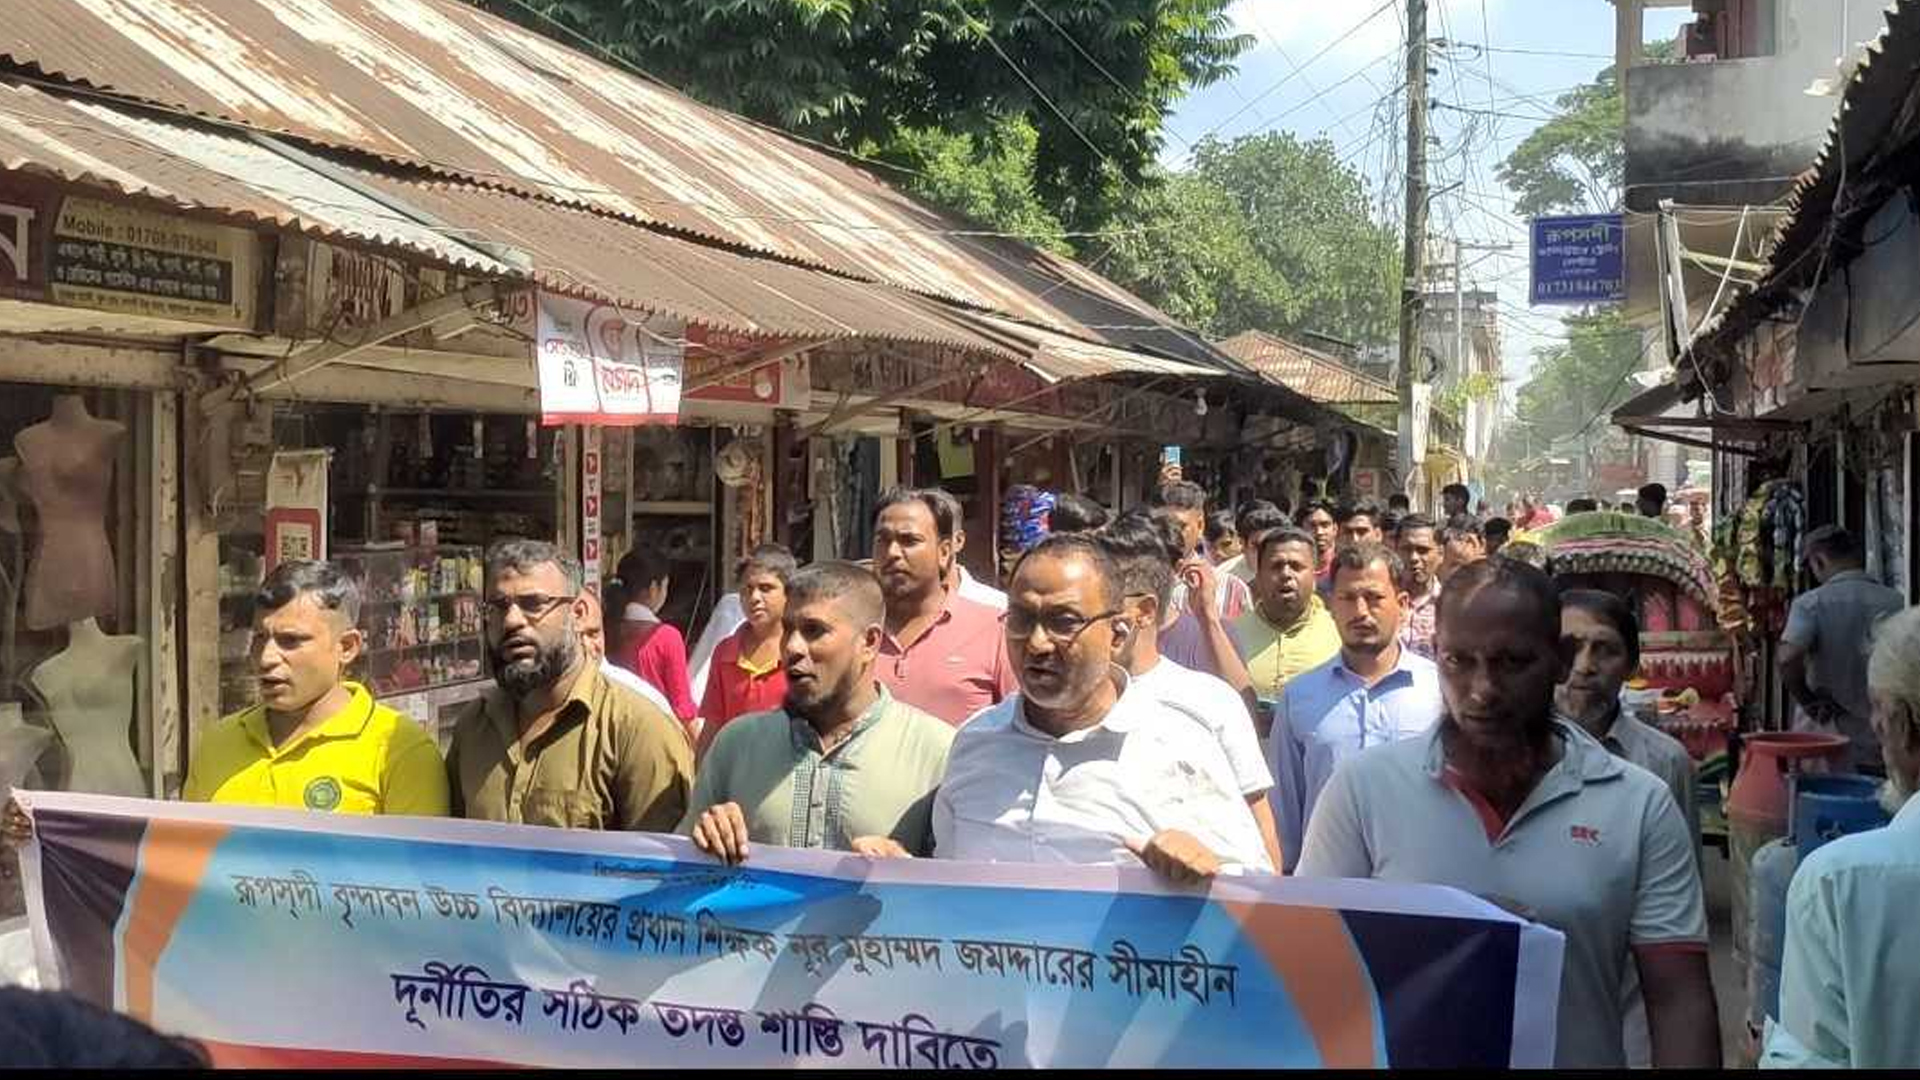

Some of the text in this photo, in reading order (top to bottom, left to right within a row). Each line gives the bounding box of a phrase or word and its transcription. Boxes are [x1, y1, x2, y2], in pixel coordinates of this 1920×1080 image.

[64, 214, 113, 239] Mobile
[333, 883, 422, 928] বৃন্দাবন
[427, 884, 480, 921] উচ্চ
[488, 886, 621, 944] বিদ্যালয়ের
[625, 907, 685, 952] প্রধান
[696, 907, 775, 960] শিক্ষক
[843, 932, 942, 975] মুহাম্মদ
[952, 938, 1098, 991] জমদ্দারের
[1104, 939, 1239, 1007] সীমাহীন
[390, 960, 1002, 1070] দূর্নীতির সঠিক তদন্ত শাস্তি দাবিতে
